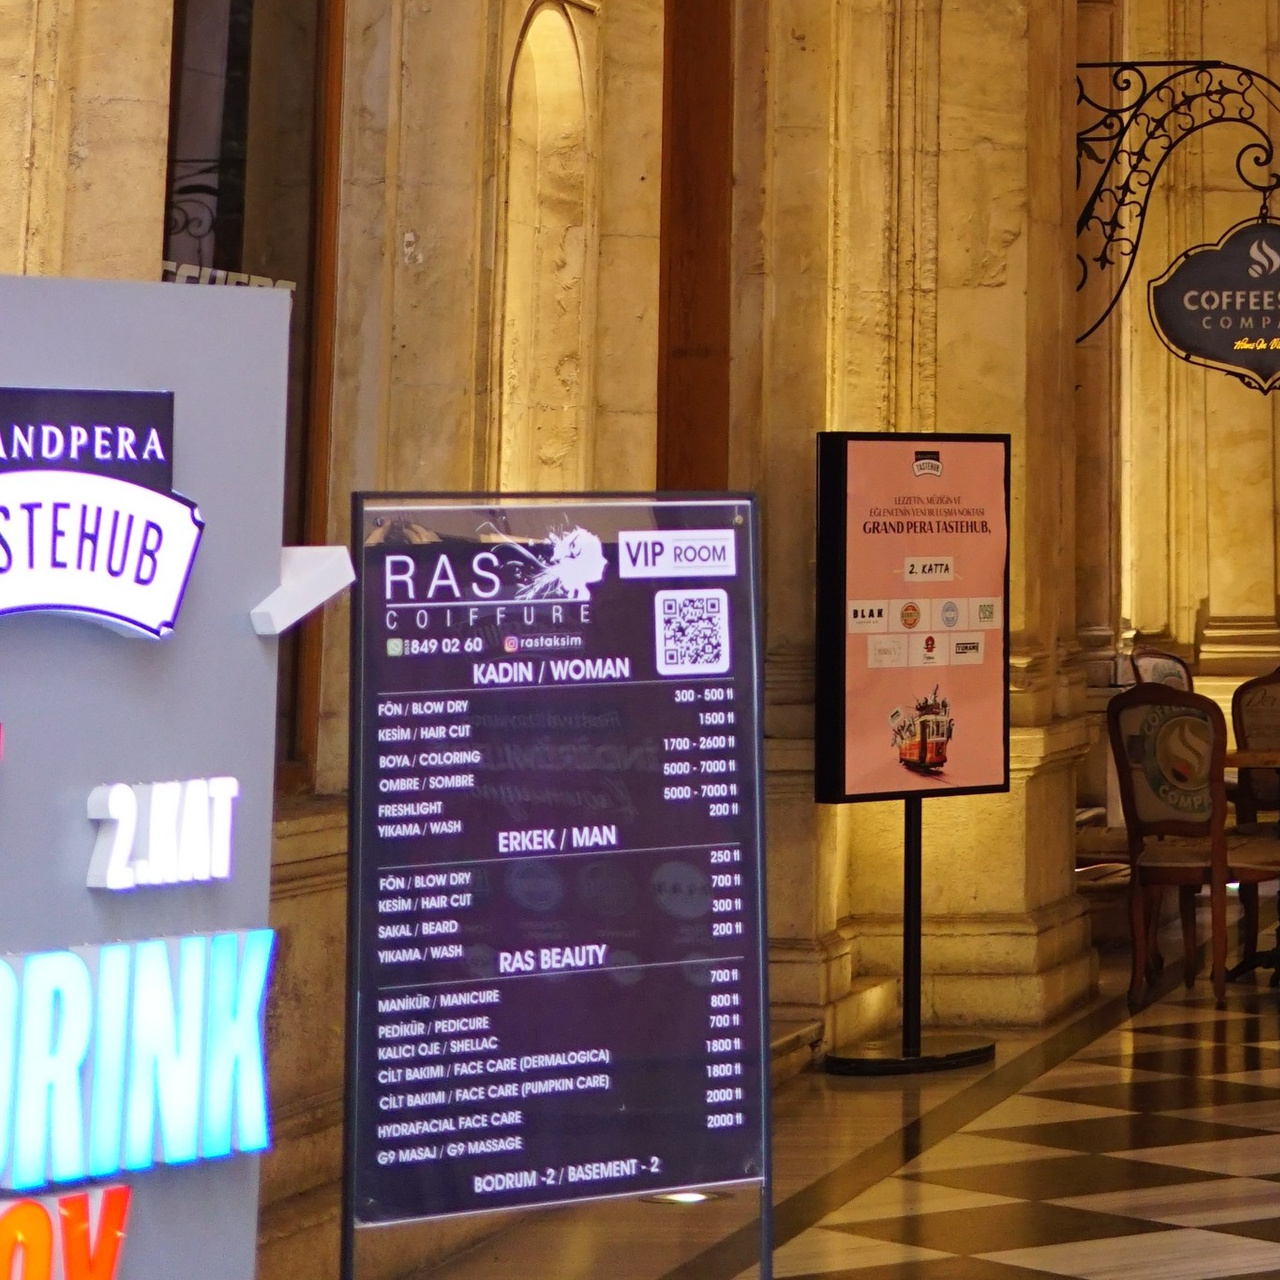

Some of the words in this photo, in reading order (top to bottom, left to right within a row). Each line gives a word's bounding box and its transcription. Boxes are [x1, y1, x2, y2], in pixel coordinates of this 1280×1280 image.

[863, 521, 904, 534] GRAND
[906, 520, 933, 534] PERA
[626, 542, 664, 567] VIP
[673, 545, 727, 563] ROOM
[385, 553, 500, 600] RAS
[909, 564, 918, 575] 2.
[921, 563, 950, 574] KATTA
[386, 604, 591, 630] COIFFURE
[853, 609, 884, 619] BLAK
[411, 638, 438, 654] 849
[442, 638, 460, 653] 02
[464, 637, 483, 652] 60
[521, 635, 582, 648] rastaksim
[473, 662, 533, 685] KADIN
[551, 657, 630, 681] WOMAN
[675, 690, 694, 702] 300
[704, 688, 723, 700] 500
[378, 701, 402, 716] FÖN
[412, 702, 444, 715] BLOW
[447, 700, 468, 713] DRY
[699, 712, 725, 724] 1500
[378, 726, 411, 741] KESİM
[420, 726, 446, 739] HAIR
[449, 725, 471, 737] CUT
[664, 738, 690, 751] 1700
[700, 736, 725, 749] 2600
[379, 755, 410, 768] BOYA
[419, 751, 481, 766] COLORING
[664, 762, 690, 775] 5000
[701, 760, 726, 772] 7000
[379, 778, 419, 792] OMBRE
[429, 775, 474, 789] SOMBRE
[664, 787, 690, 800] 5000
[701, 785, 727, 797] 7000
[378, 801, 442, 817] FRESHLIGHT
[710, 804, 729, 816] 200
[378, 823, 421, 837] YIKAMA
[430, 820, 461, 834] WASH
[498, 829, 555, 852] ERKEK
[572, 825, 616, 847] MAN
[710, 850, 730, 863] 250
[379, 875, 405, 890] FÖN
[415, 874, 446, 888] BLOW
[450, 872, 471, 885] DRY
[712, 874, 731, 887] 700
[378, 897, 411, 912] KESİM
[421, 895, 447, 909] HAIR
[451, 894, 472, 907] CUT
[712, 899, 732, 912] 300
[378, 925, 412, 938] SAKAL
[422, 920, 458, 934] BEARD
[713, 923, 732, 936] 200
[378, 948, 421, 963] YIKAMA
[430, 945, 462, 959] WASH
[499, 951, 534, 973] RAS
[540, 944, 607, 970] BEAUTY
[711, 970, 730, 982] 700
[378, 994, 430, 1012] MANİKÜR
[440, 990, 499, 1007] MANICURE
[711, 994, 730, 1007] 800
[378, 1020, 425, 1039] PEDİKÜR
[435, 1016, 490, 1034] PEDICURE
[710, 1015, 730, 1028] 700
[378, 1044, 415, 1060] KALICI
[418, 1042, 440, 1056] OJE
[450, 1036, 498, 1053] SHELLAC
[706, 1039, 731, 1053] 1800
[0, 929, 275, 1192] RINK
[378, 1067, 402, 1084] CİLT
[406, 1065, 444, 1081] BAKIMI
[454, 1061, 483, 1076] FACE
[487, 1058, 517, 1073] CARE
[520, 1048, 610, 1072] (DERMALOGICA)
[706, 1064, 731, 1078] 1800
[379, 1093, 404, 1110] CİLT
[407, 1091, 445, 1107] BAKIMI
[456, 1087, 485, 1102] FACE
[488, 1083, 518, 1099] CARE
[522, 1077, 573, 1098] (PUMPKIN
[577, 1074, 610, 1090] CARE)
[706, 1089, 732, 1103] 2000
[378, 1118, 455, 1138] HYDRAFACIAL
[459, 1114, 488, 1129] FACE
[491, 1111, 522, 1126] CARE
[707, 1114, 733, 1128] 2000
[377, 1150, 395, 1165] G9
[399, 1146, 437, 1162] MASAJ
[447, 1142, 465, 1157] G9
[468, 1137, 522, 1154] MASSAGE
[474, 1171, 537, 1193] BODRUM
[568, 1159, 637, 1182] BASEMENT
